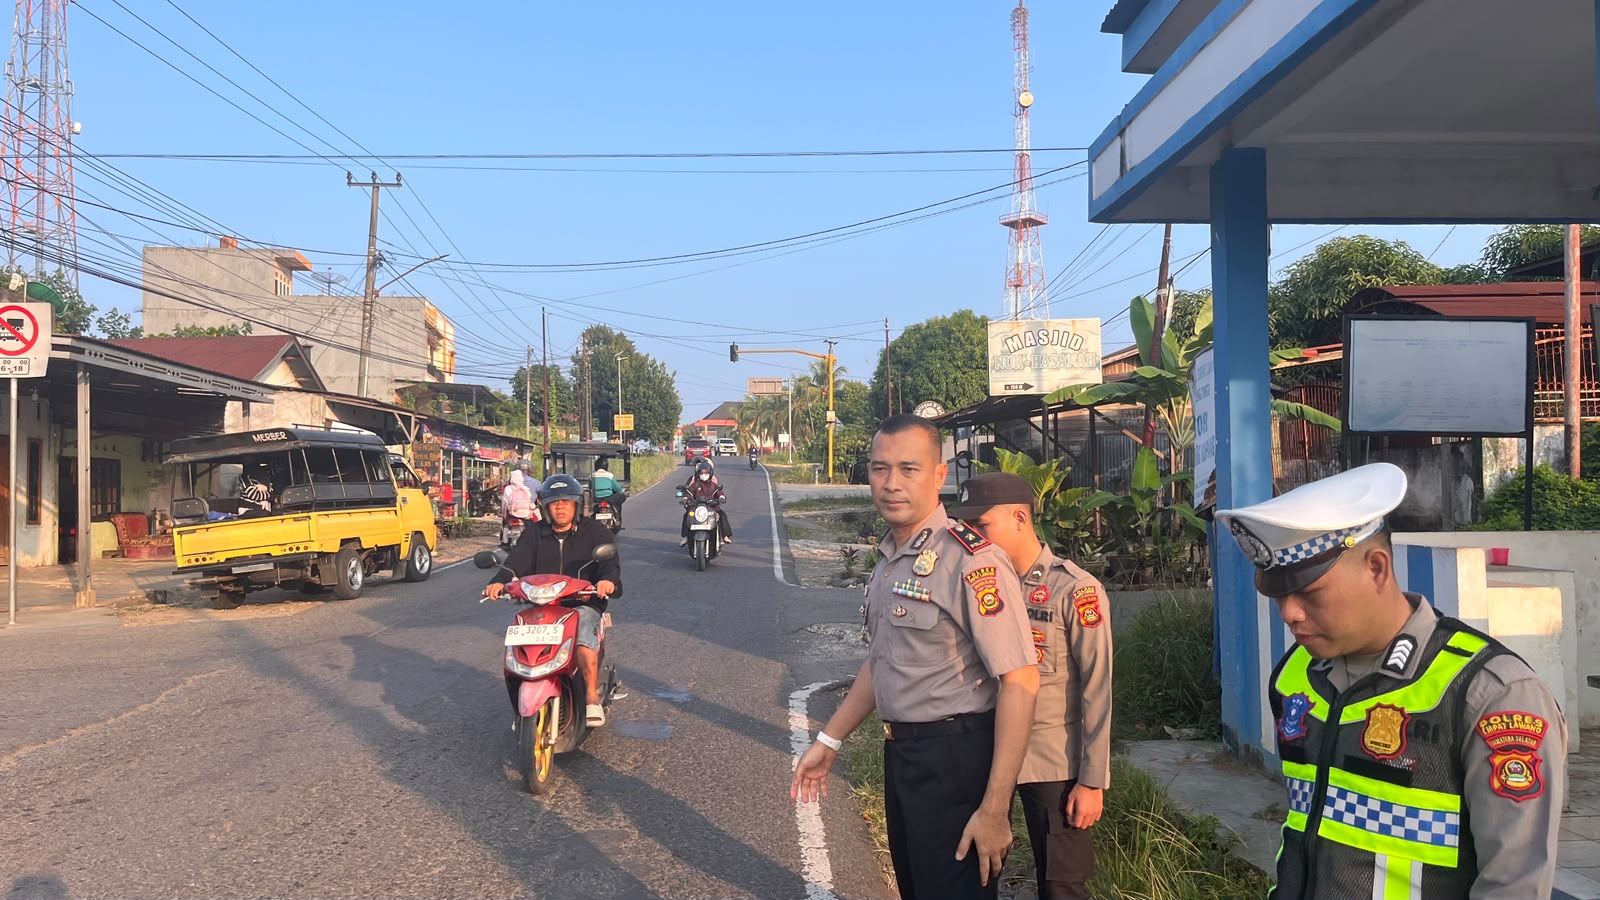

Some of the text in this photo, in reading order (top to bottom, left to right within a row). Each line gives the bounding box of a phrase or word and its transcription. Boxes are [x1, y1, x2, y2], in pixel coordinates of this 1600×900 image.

[1005, 329, 1084, 353] MASJID
[252, 432, 288, 442] MERBER
[1027, 608, 1054, 623] OLRI
[508, 627, 519, 635] BG
[526, 626, 547, 634] 3207
[1480, 714, 1543, 728] POLRES
[1509, 721, 1542, 734] LAWANG
